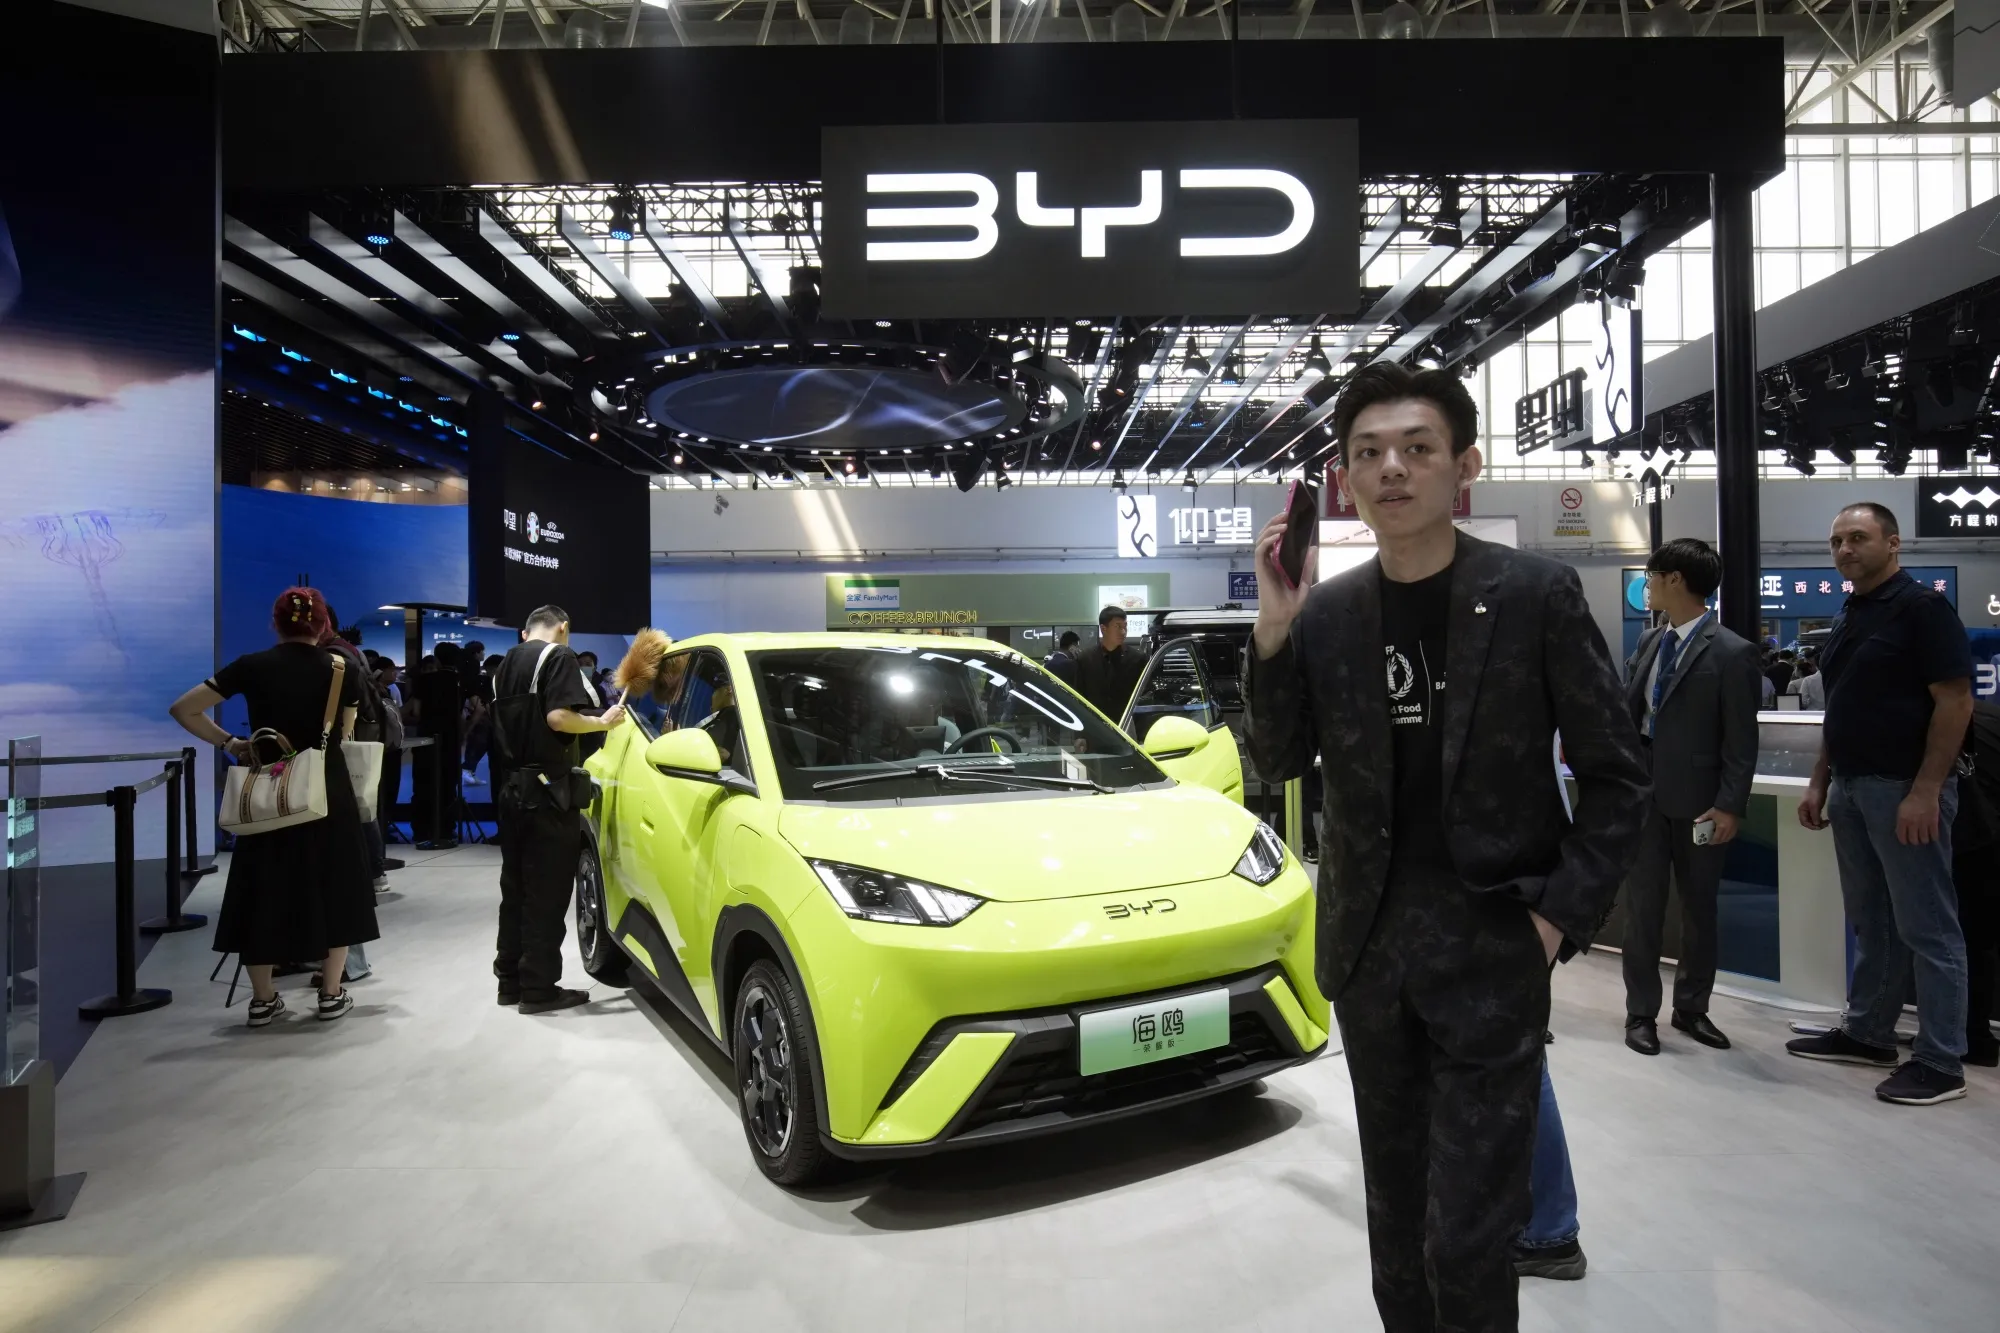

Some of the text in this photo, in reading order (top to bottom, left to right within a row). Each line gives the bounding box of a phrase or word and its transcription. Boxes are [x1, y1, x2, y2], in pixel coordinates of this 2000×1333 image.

[866, 169, 1315, 261] BYD
[1631, 483, 1673, 508] 方程豹
[1168, 507, 1254, 545] 仰望
[1949, 514, 1998, 527] 方程豹
[846, 593, 898, 603] 全家 FamilyMart
[1385, 645, 1395, 655] FP
[1398, 703, 1421, 713] Food
[1102, 898, 1177, 920] BYD
[1132, 1008, 1185, 1045] 海鸥
